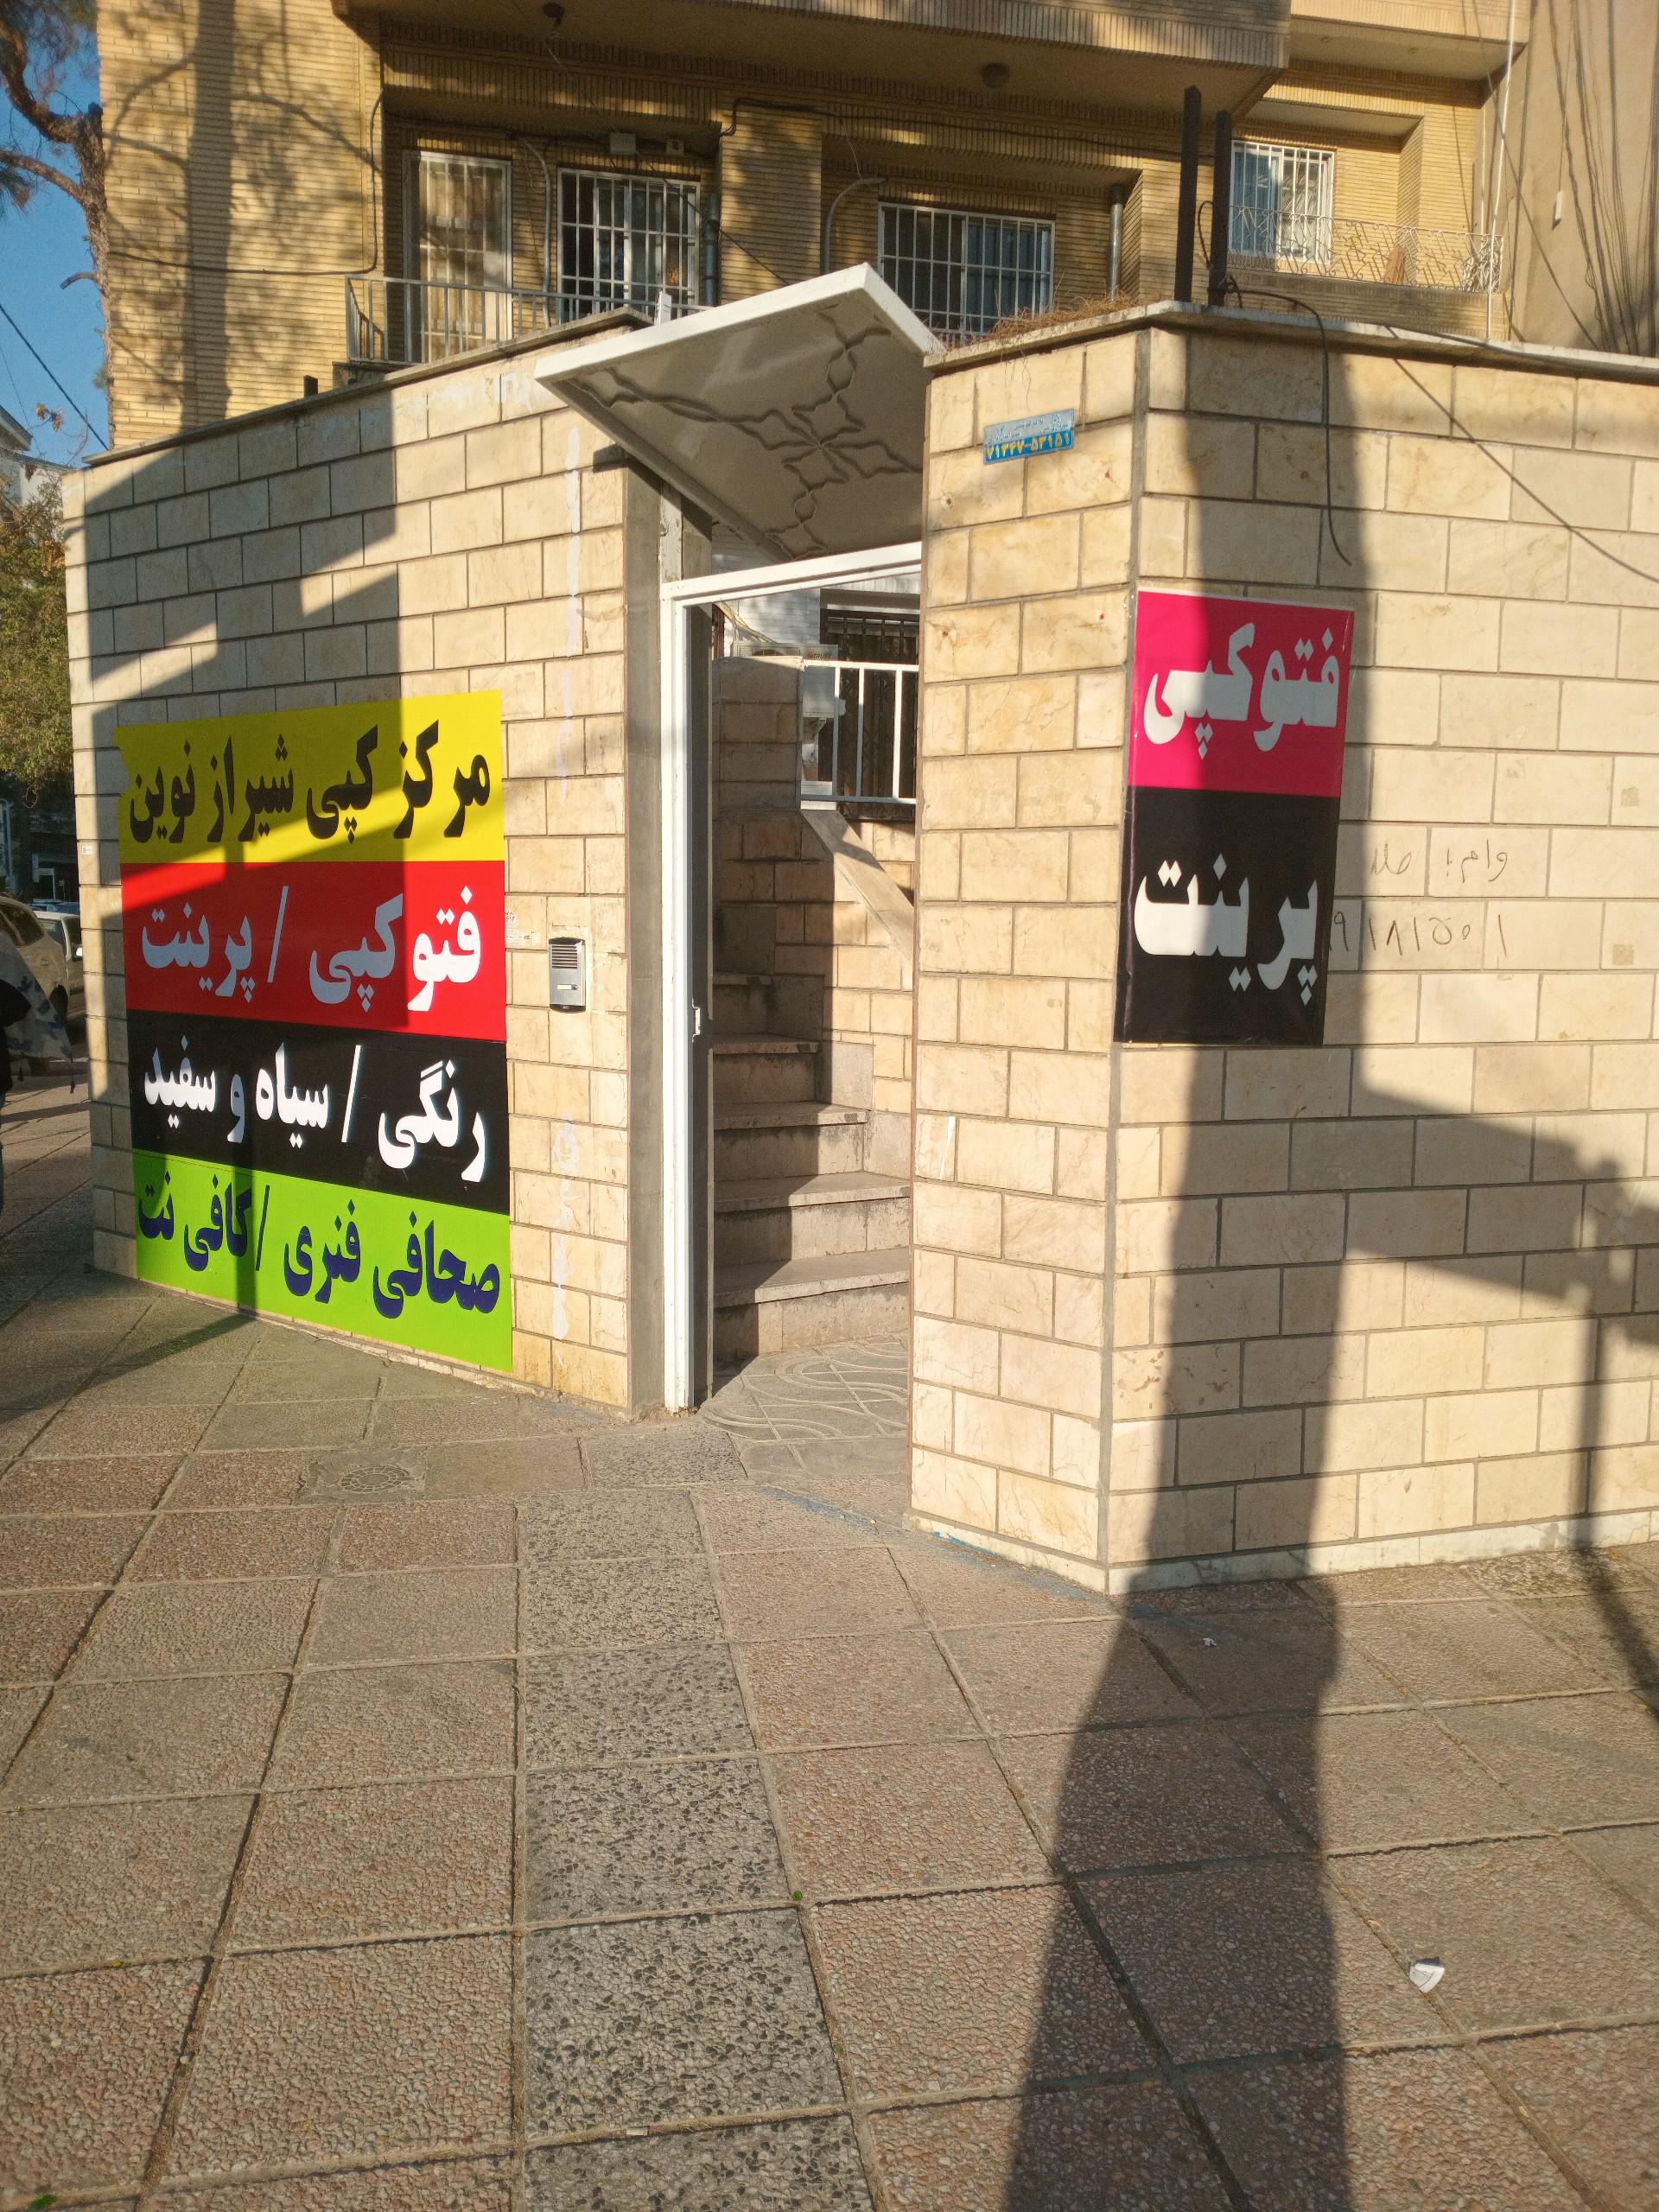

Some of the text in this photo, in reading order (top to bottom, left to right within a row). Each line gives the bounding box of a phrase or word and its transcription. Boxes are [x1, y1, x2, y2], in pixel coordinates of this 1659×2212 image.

[1143, 622, 1339, 760] فتوکپی
[130, 719, 490, 844] مرکز کپی شیراز نوین
[142, 902, 256, 1003] پرینت
[308, 885, 484, 1013] فتوکپی
[1135, 853, 1319, 1006] پرینت
[144, 1035, 216, 1129] سفید
[227, 1073, 245, 1143] و
[255, 1042, 329, 1149] سیاه
[378, 1059, 486, 1183] رنگی
[138, 1170, 175, 1240] نت
[183, 1173, 252, 1272] کافی
[283, 1198, 361, 1304] فنری
[372, 1211, 500, 1319] صحافی
